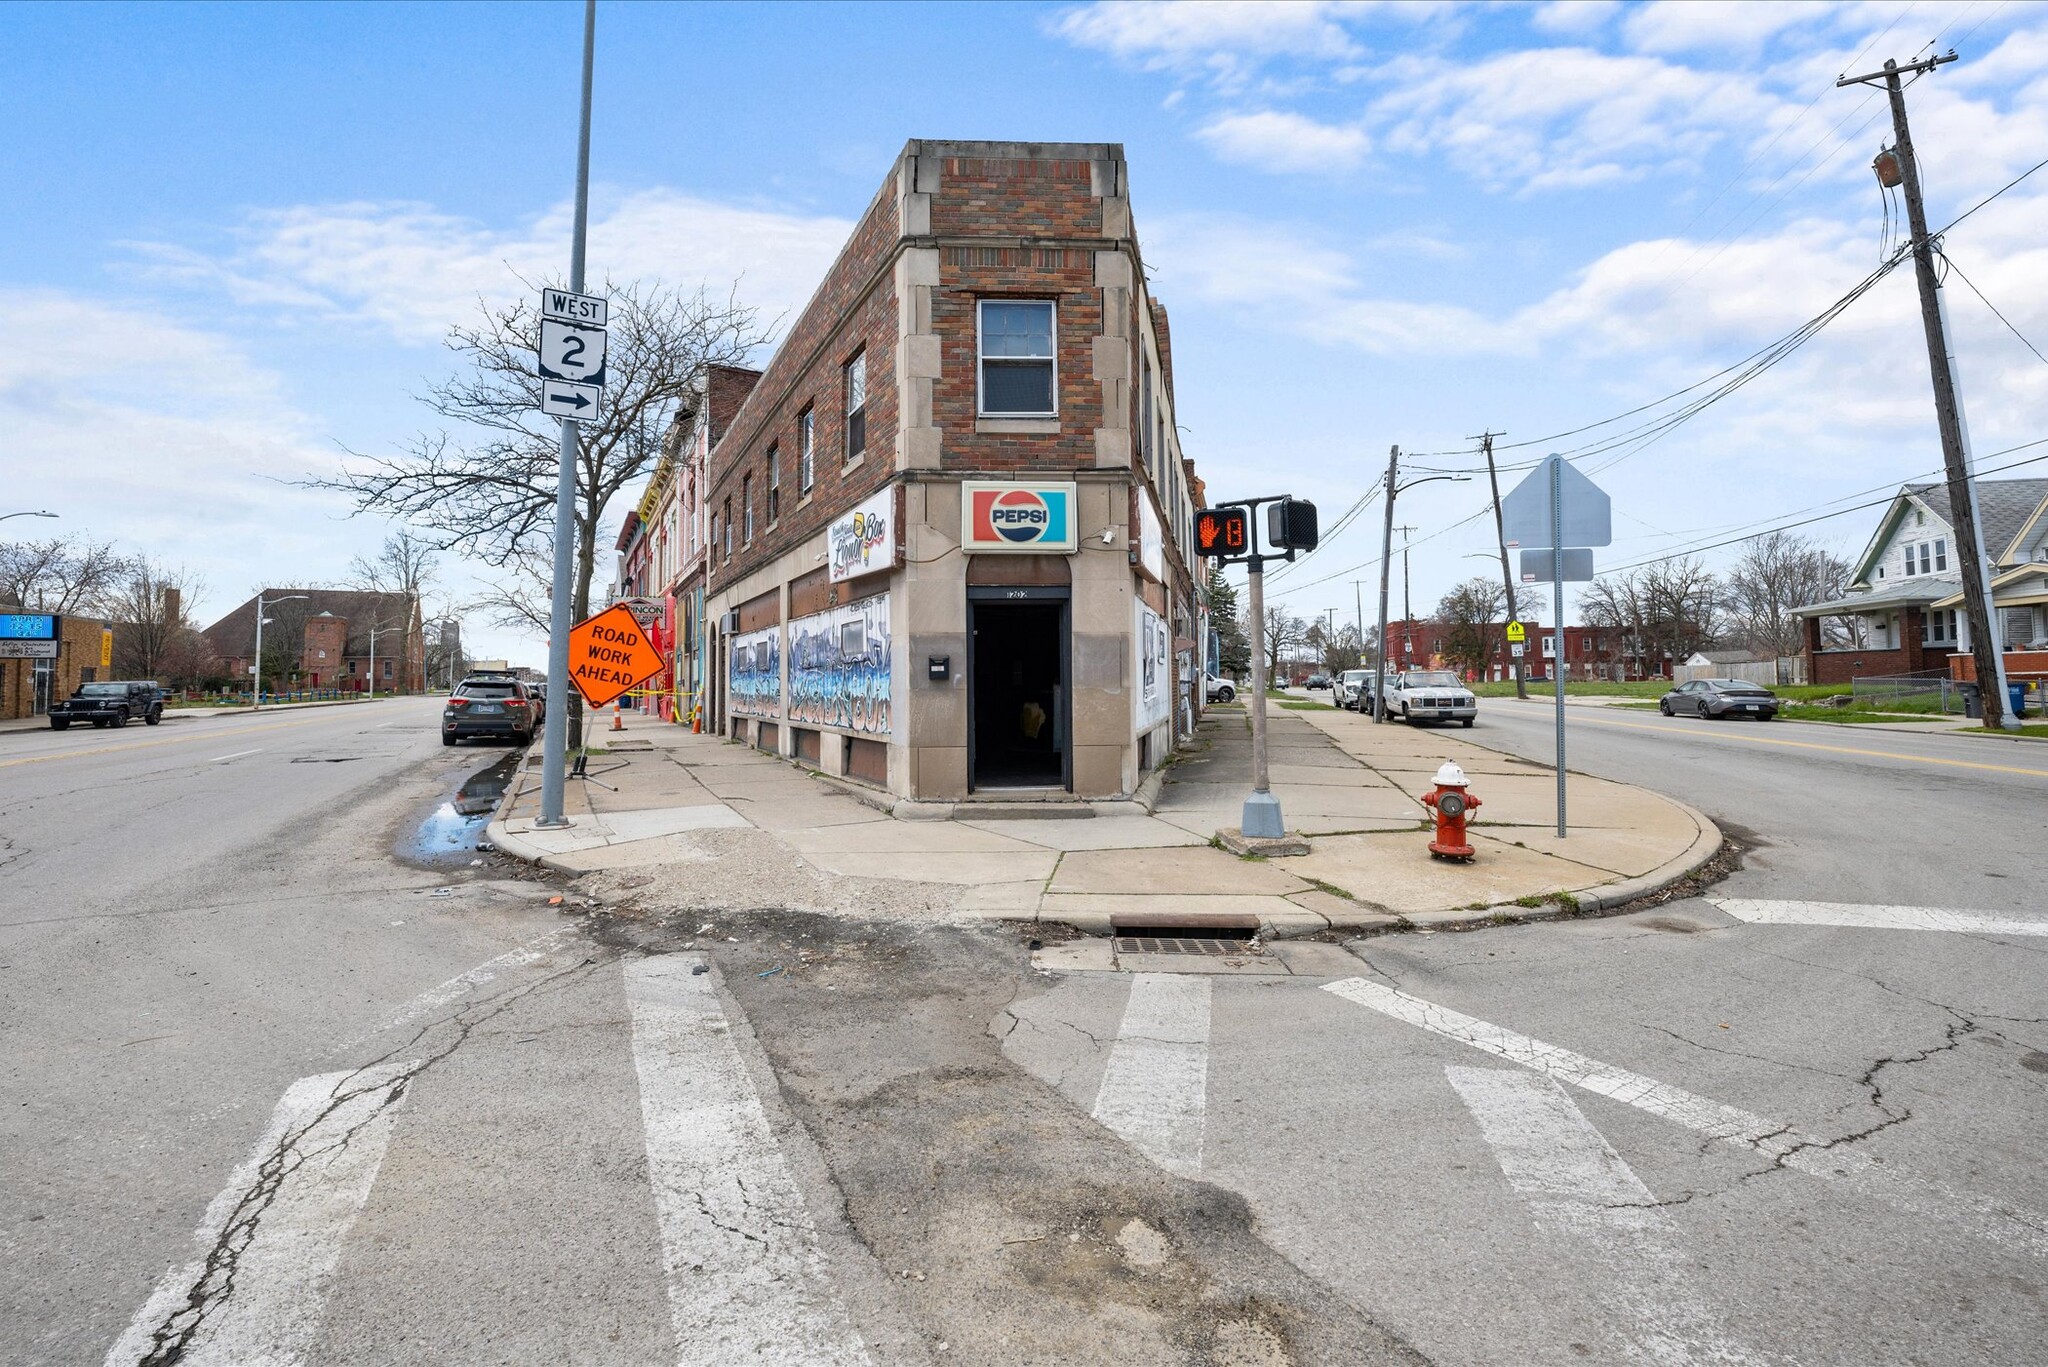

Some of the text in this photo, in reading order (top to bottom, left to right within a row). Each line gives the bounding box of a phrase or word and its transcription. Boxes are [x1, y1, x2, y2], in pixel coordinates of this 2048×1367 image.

[552, 294, 599, 319] WEST
[561, 335, 586, 368] 2
[865, 512, 886, 542] Box
[992, 509, 1047, 524] PEPSI
[1006, 590, 1028, 599] 1202
[592, 625, 638, 646] ROAD
[588, 644, 633, 666] WORK
[575, 663, 633, 686] AHEAD
